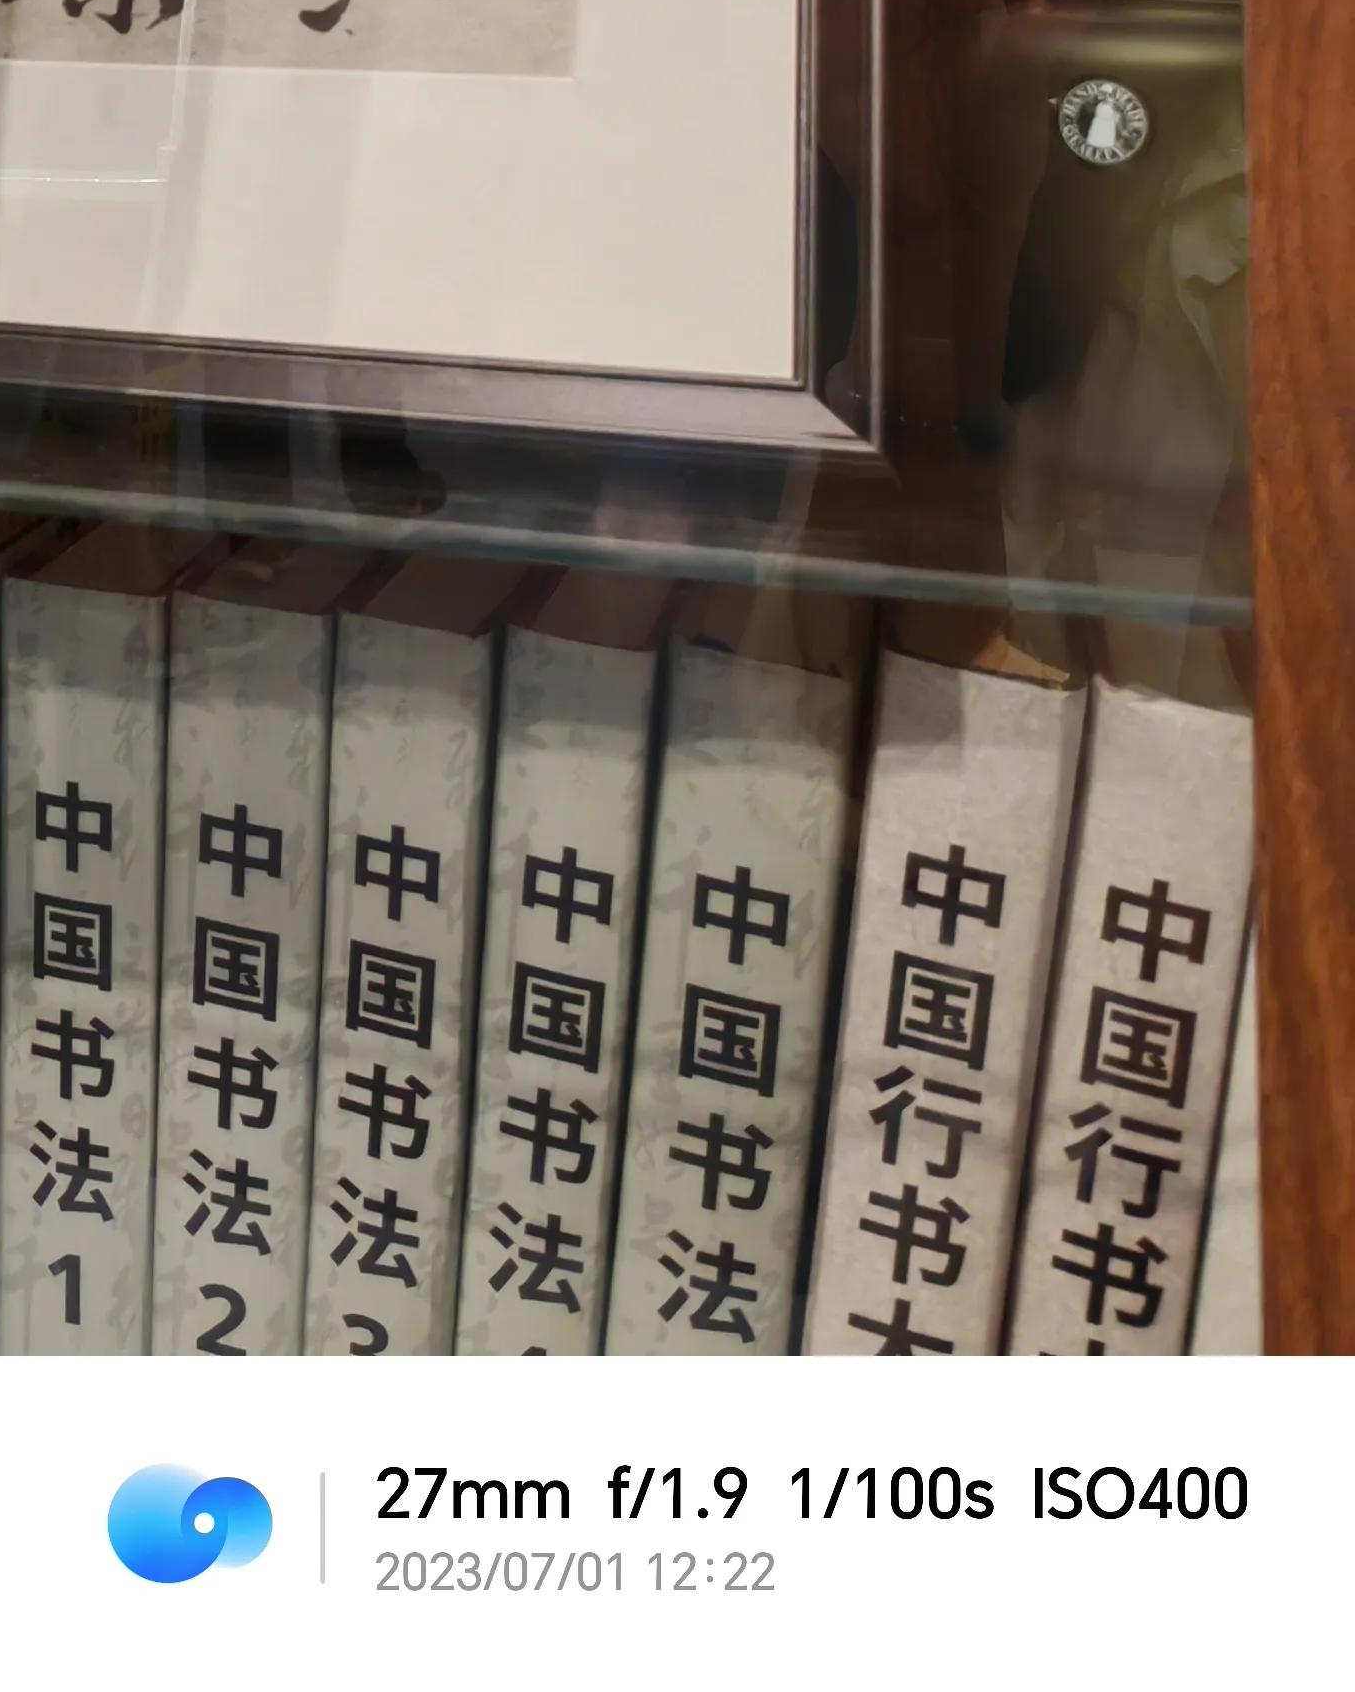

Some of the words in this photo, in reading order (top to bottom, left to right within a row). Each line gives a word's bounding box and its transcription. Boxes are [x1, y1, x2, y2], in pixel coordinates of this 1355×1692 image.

[657, 865, 791, 1343] 中国书法
[1038, 878, 1212, 1355] 中国行书
